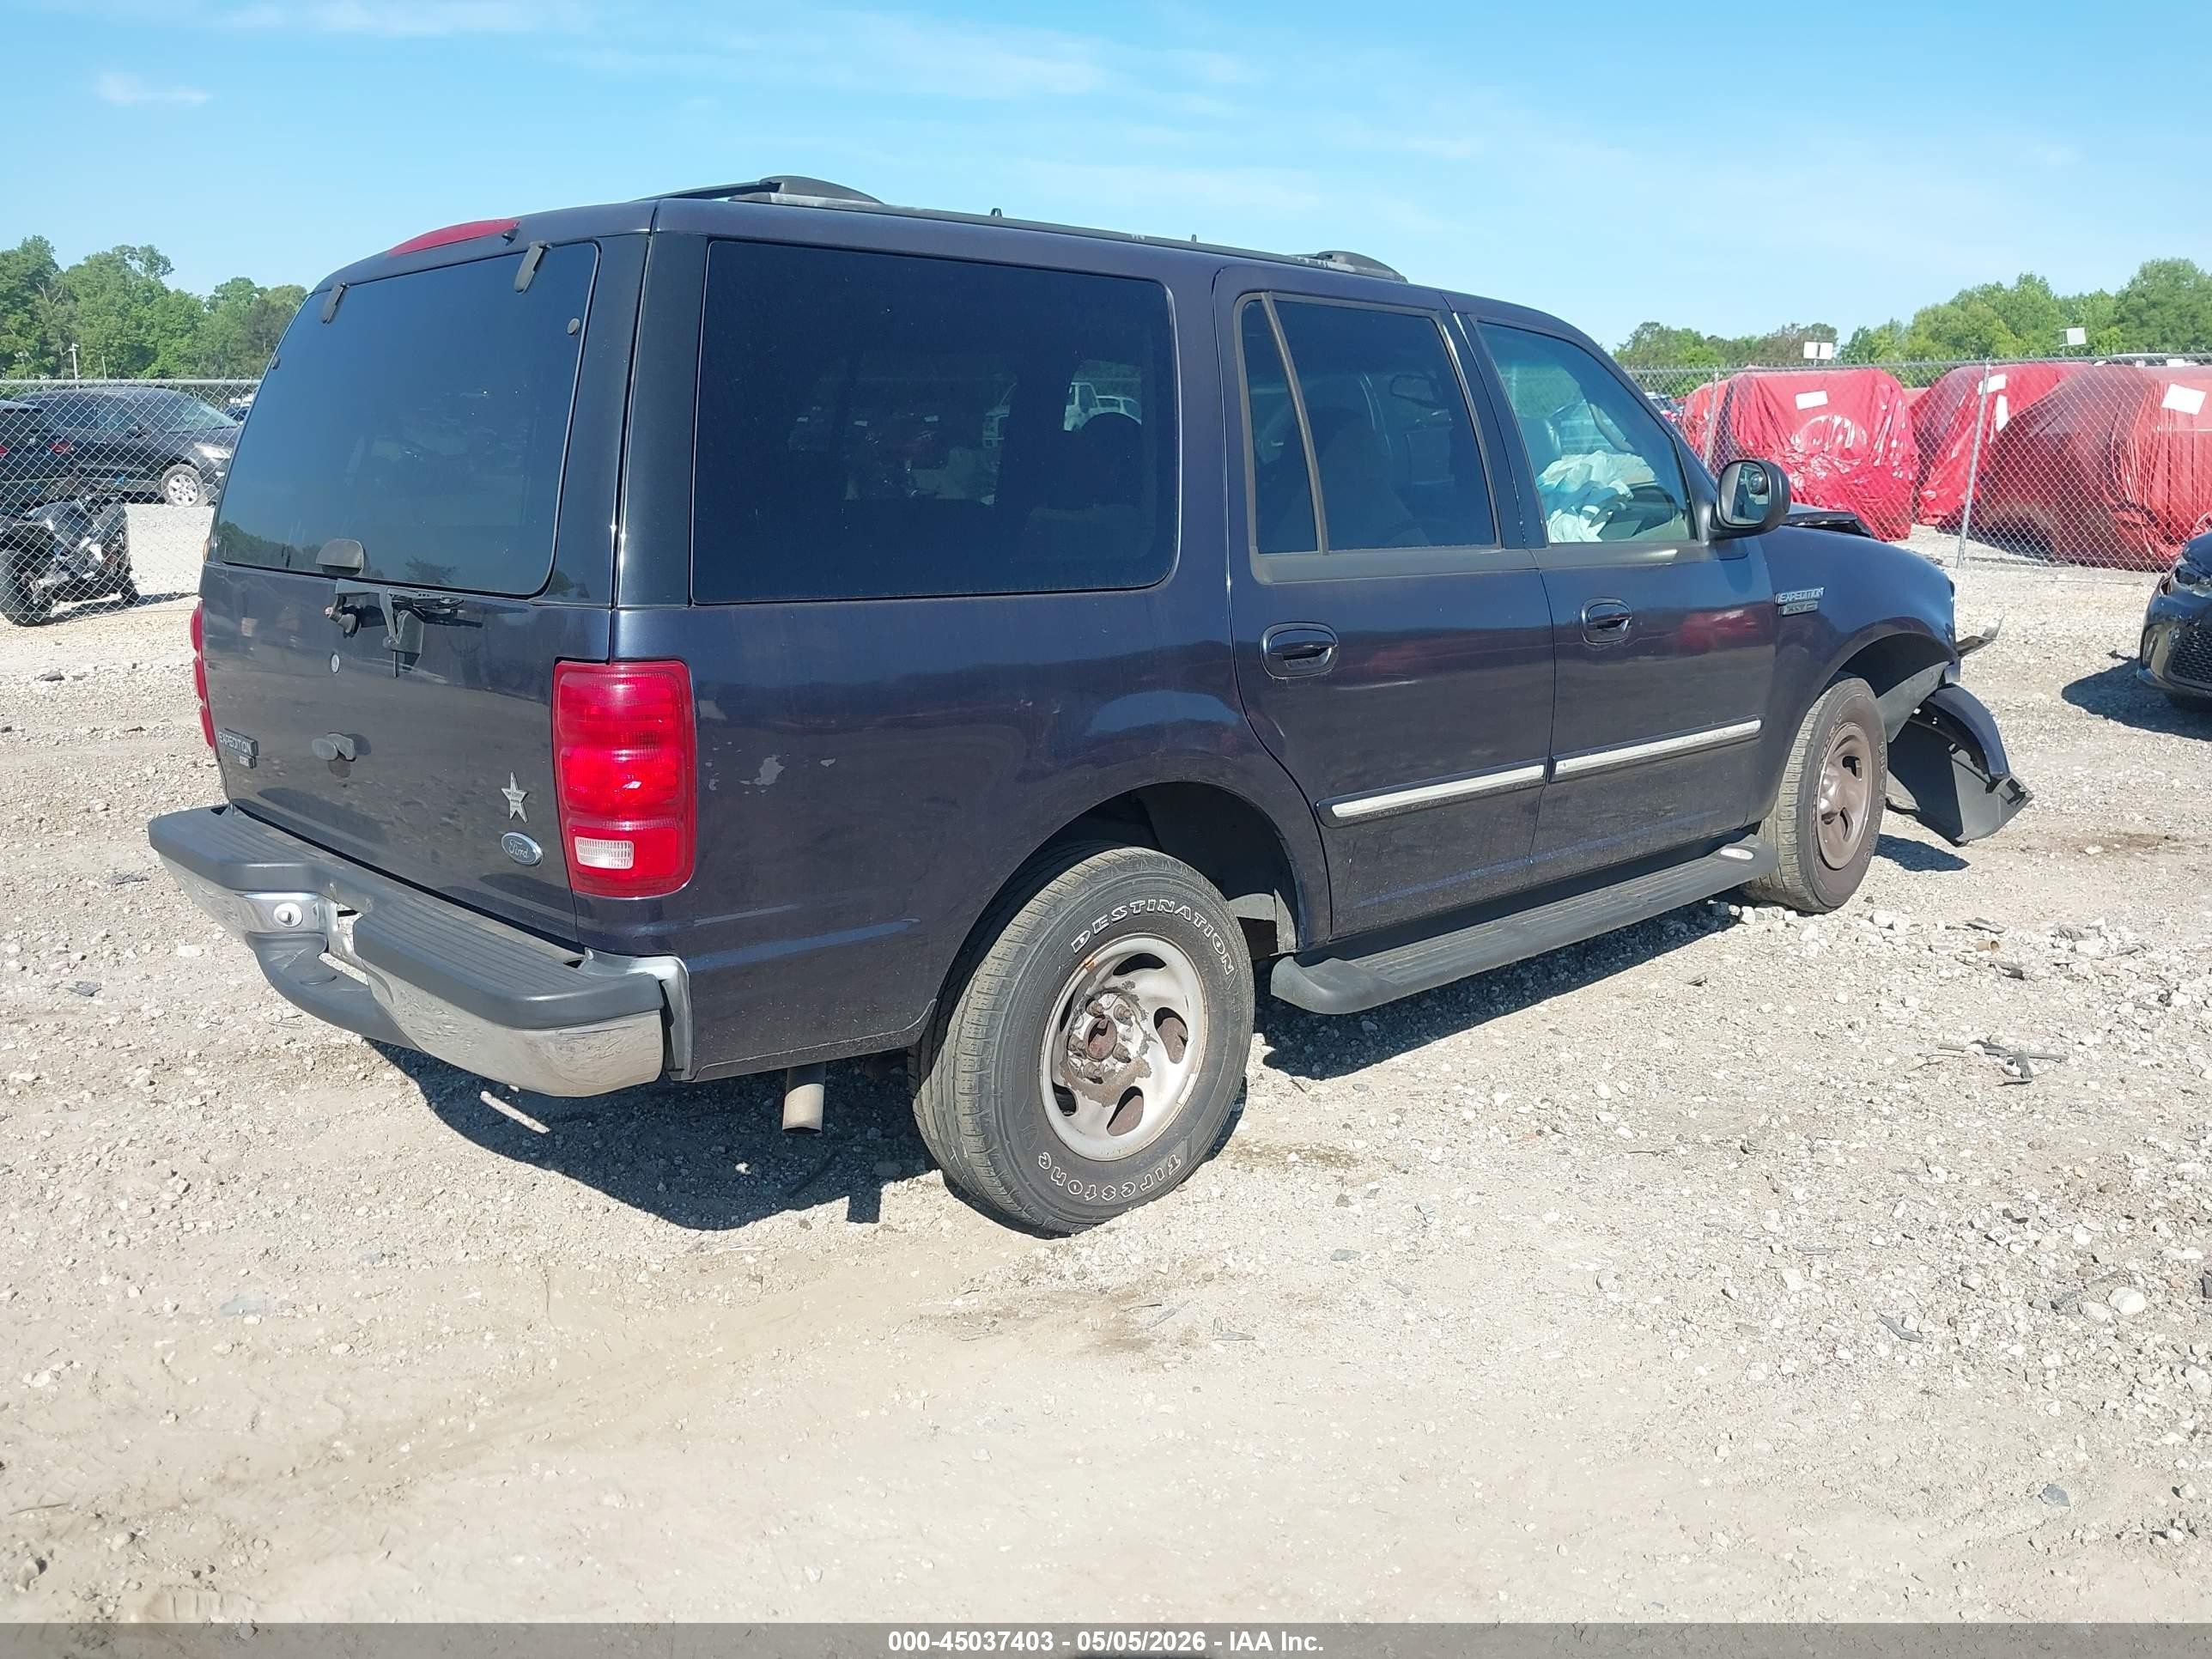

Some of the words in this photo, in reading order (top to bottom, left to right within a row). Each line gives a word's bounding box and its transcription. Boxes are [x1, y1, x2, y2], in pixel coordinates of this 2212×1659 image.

[218, 731, 252, 756] EXPEDITION
[508, 838, 531, 859] Ford
[1070, 898, 1235, 976] DESTINATION
[1037, 1152, 1182, 1201] Firestone
